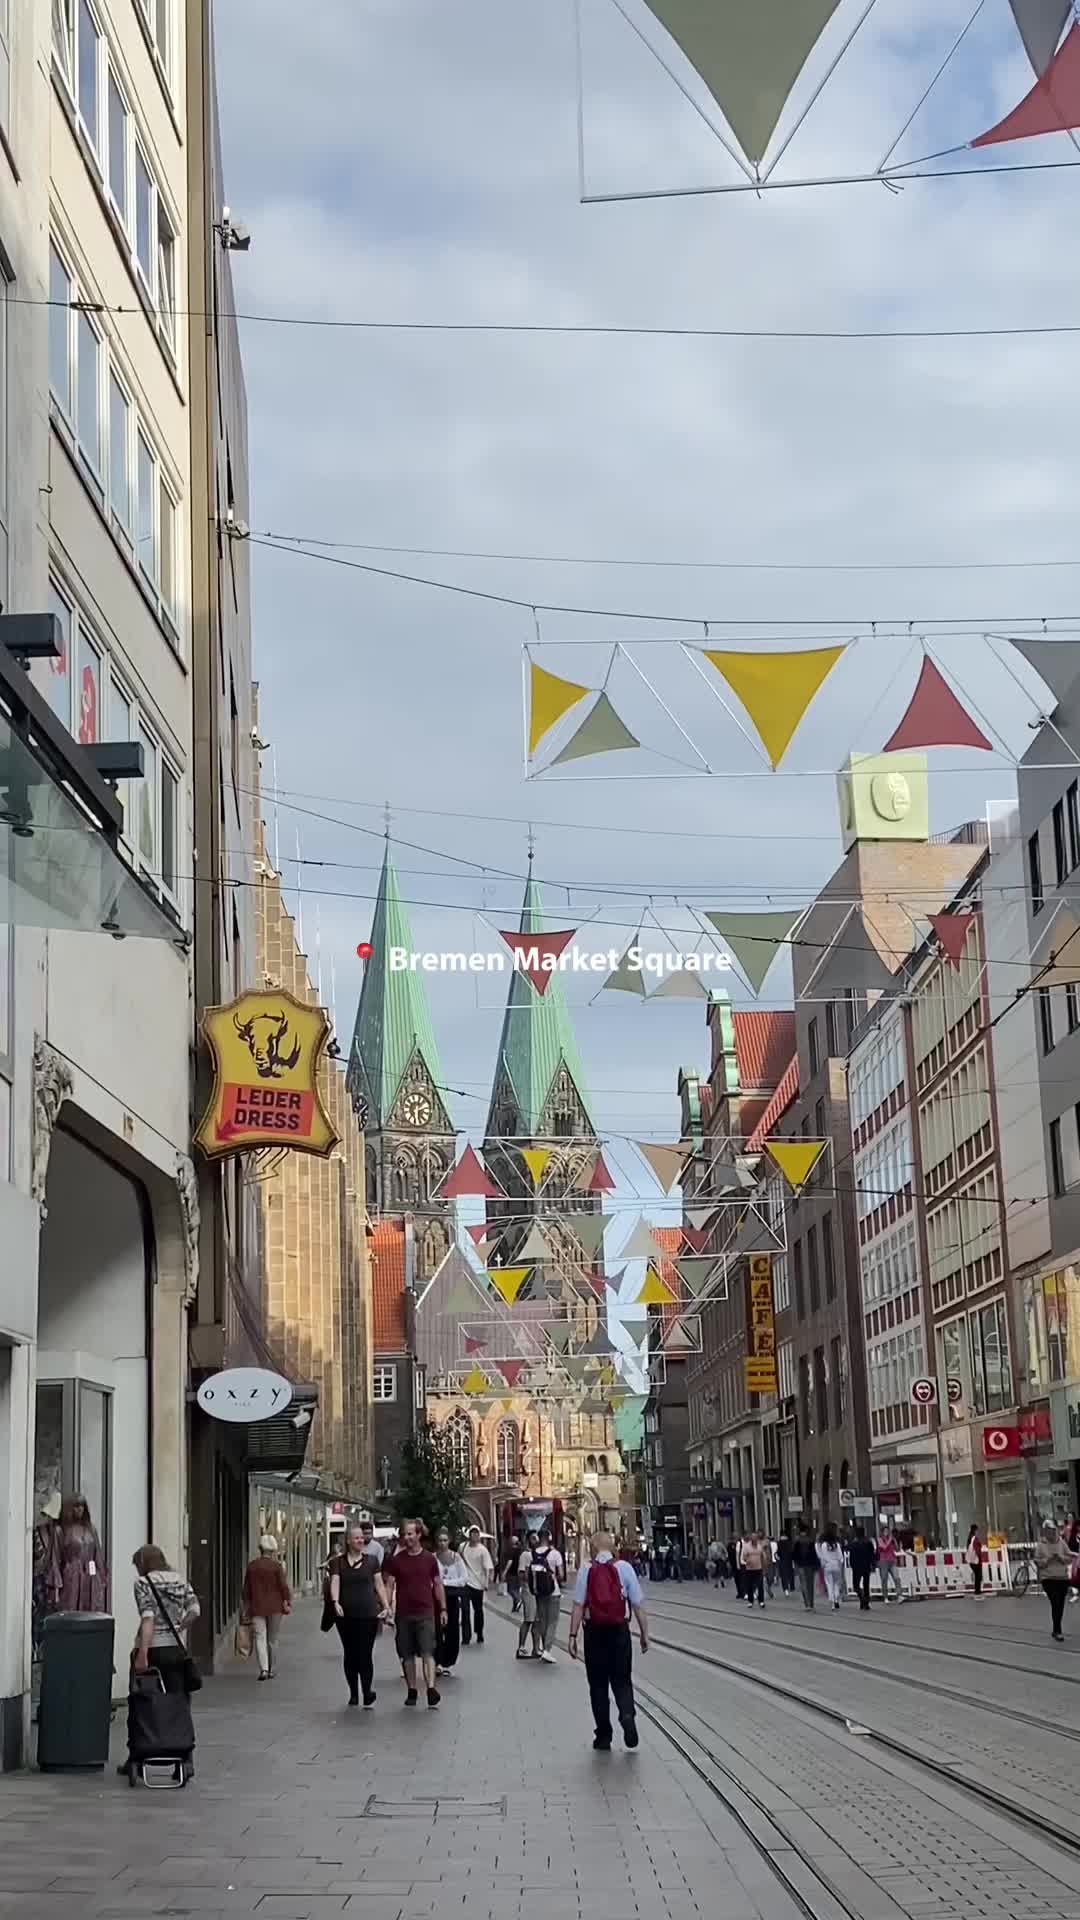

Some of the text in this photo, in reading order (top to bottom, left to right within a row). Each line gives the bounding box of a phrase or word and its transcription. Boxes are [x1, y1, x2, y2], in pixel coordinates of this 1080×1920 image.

[236, 1087, 301, 1110] LEDER
[234, 1108, 299, 1130] DRESS
[204, 1388, 281, 1406] oxzy
